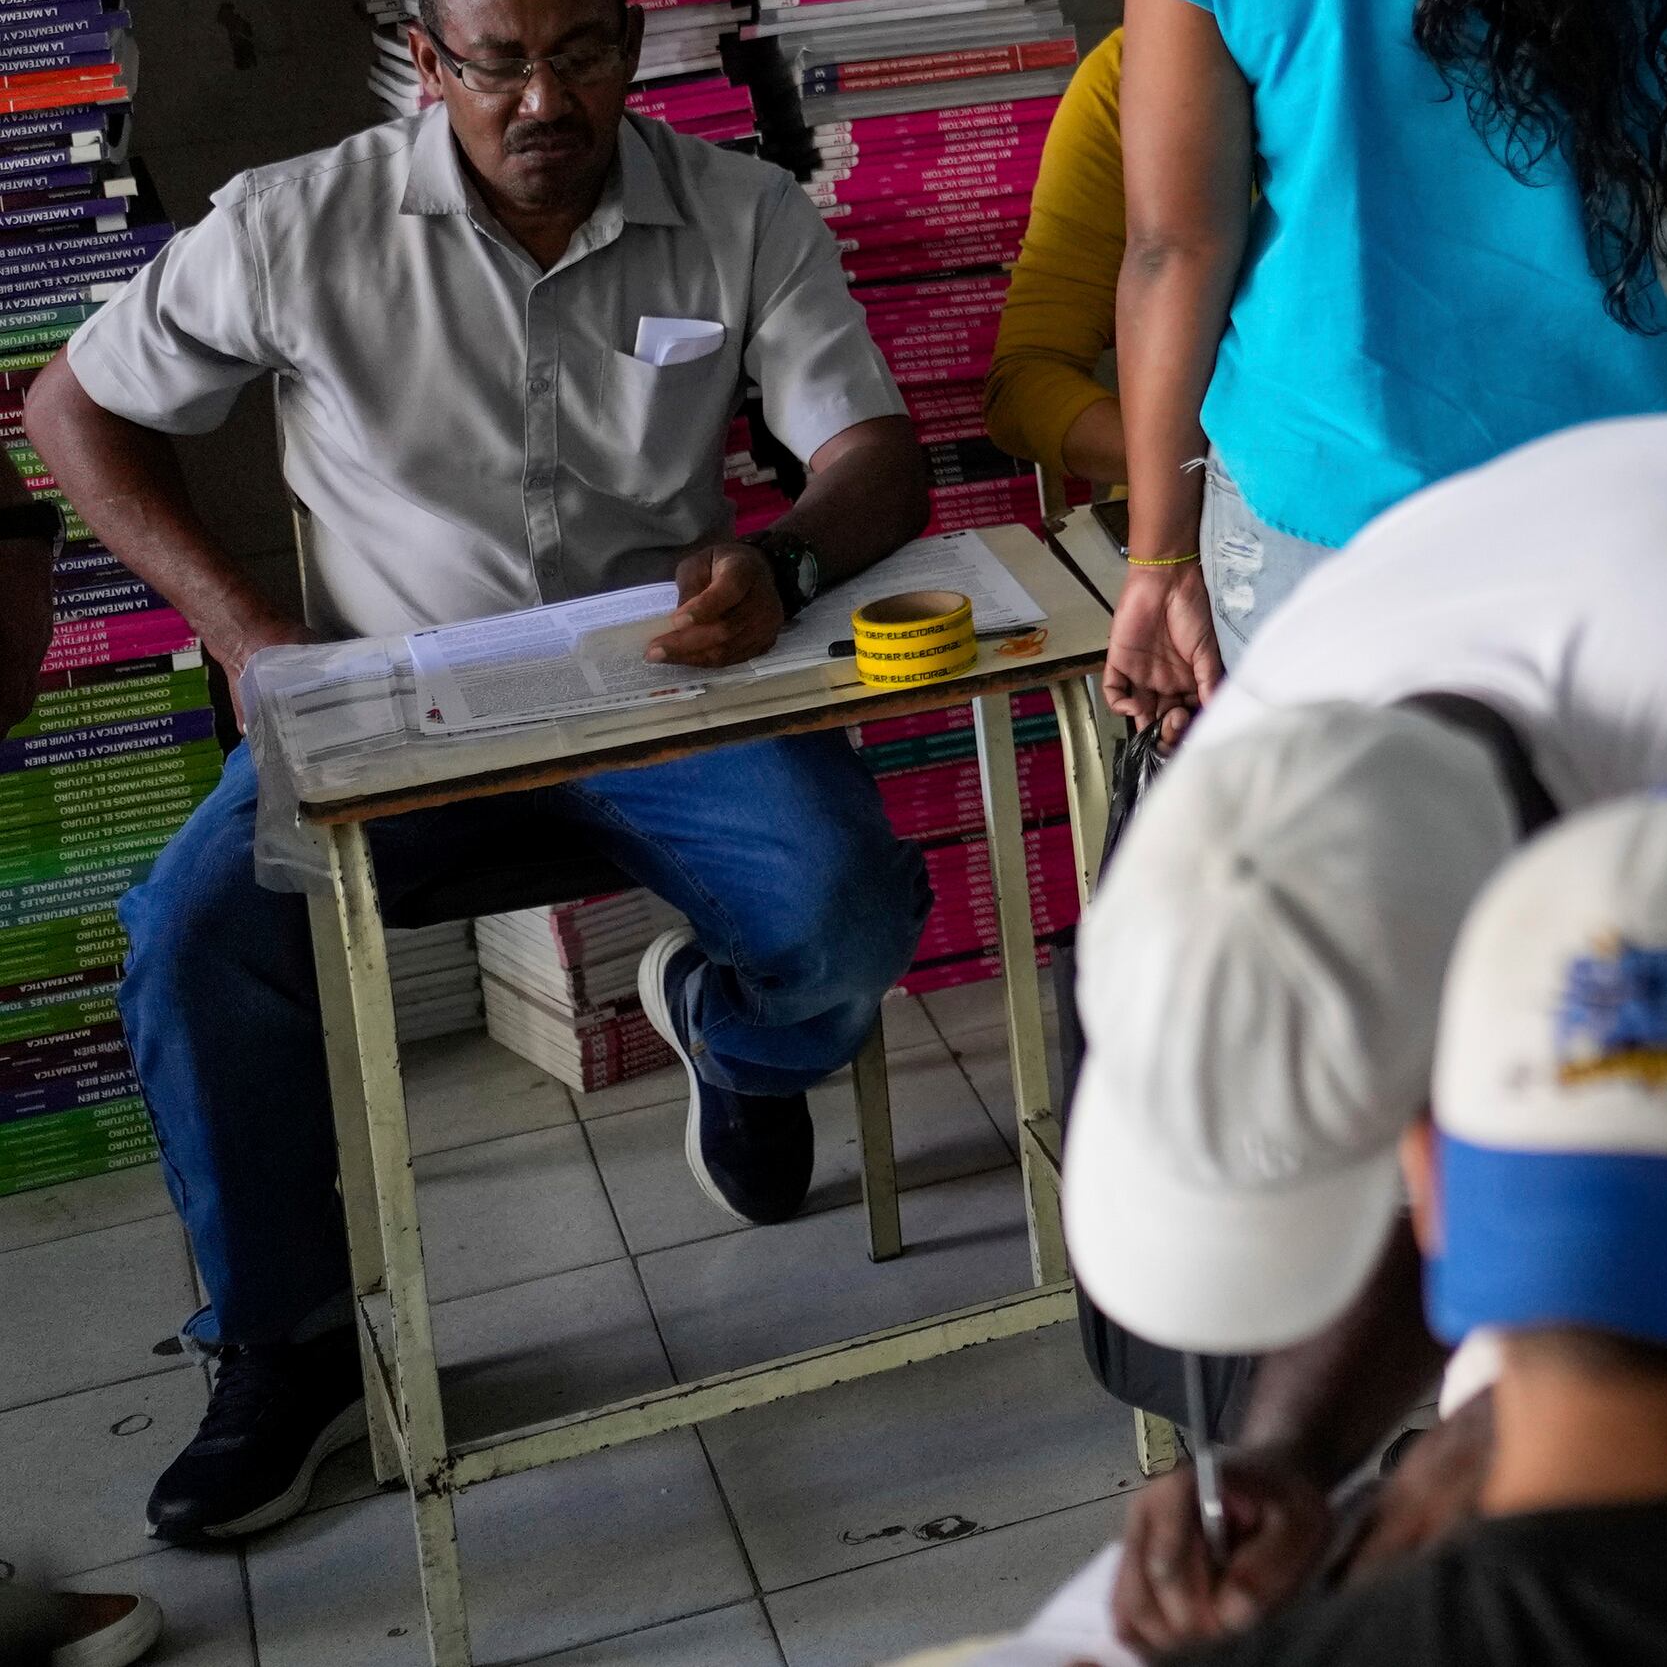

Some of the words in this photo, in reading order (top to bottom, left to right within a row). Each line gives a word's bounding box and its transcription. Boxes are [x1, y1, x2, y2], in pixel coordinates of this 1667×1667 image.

[76, 21, 88, 29] LA
[70, 207, 84, 215] LA
[121, 233, 133, 241] LA
[35, 245, 46, 253] EL
[133, 247, 145, 255] LA
[48, 260, 59, 268] EL
[904, 642, 961, 660] ELECTORAL
[92, 688, 170, 709] CONSTRUYAMOS
[39, 703, 78, 717] FUTURO
[79, 701, 91, 711] EL
[94, 703, 172, 722] CONSTRUYAMOS
[39, 717, 80, 731] FUTURO
[80, 715, 92, 725] EL
[160, 717, 173, 727] LA
[49, 735, 75, 746] VIVIR
[77, 732, 88, 741] EL
[160, 734, 173, 744] LA
[25, 739, 47, 751] BIEN
[49, 751, 75, 763] VIVIR
[77, 749, 88, 758] EL
[104, 745, 181, 766] CONSTRUYAMOS
[25, 756, 47, 768] BIEN
[50, 761, 89, 775] FUTURO
[90, 759, 102, 768] EL
[107, 759, 185, 780] CONSTRUYAMOS
[54, 775, 93, 789] FUTURO
[94, 773, 105, 783] EL
[107, 773, 185, 794] CONSTRUYAMOS
[54, 789, 93, 803] FUTURO
[94, 787, 106, 796] EL
[113, 785, 191, 806] CONSTRUYAMOS
[60, 801, 99, 815] FUTURO
[100, 799, 112, 808] EL
[85, 868, 132, 883] CIENCIAS
[22, 876, 84, 895] NATURALES
[82, 881, 130, 897] CIENCIAS
[19, 890, 81, 908] NATURALES
